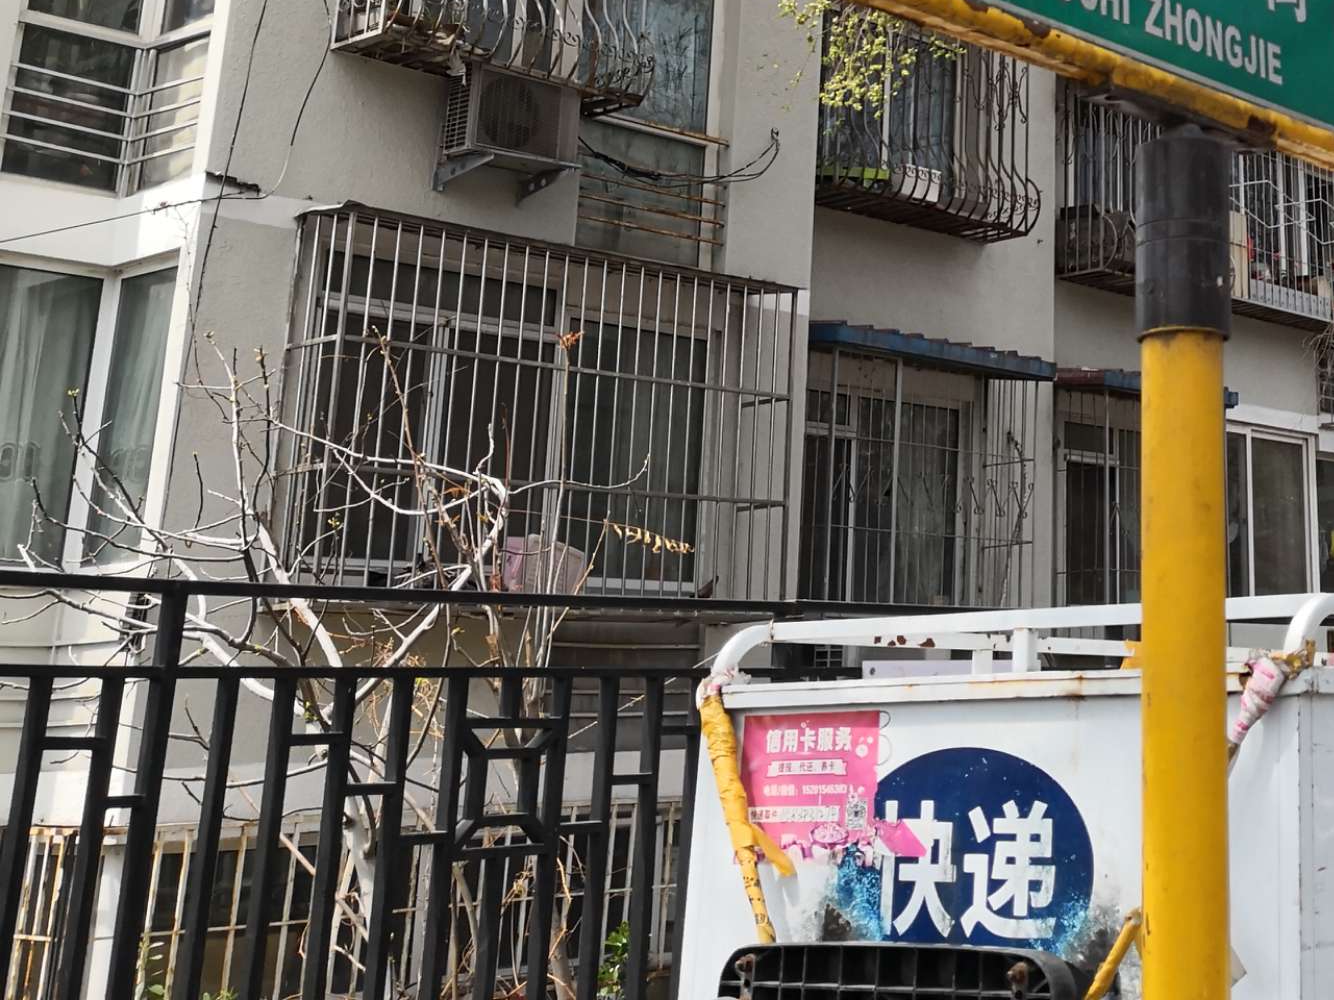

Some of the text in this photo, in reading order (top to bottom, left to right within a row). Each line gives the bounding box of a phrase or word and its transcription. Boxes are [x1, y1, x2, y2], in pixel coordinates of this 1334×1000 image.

[766, 727, 852, 753] 信用卡服务
[881, 800, 1056, 938] 快递
